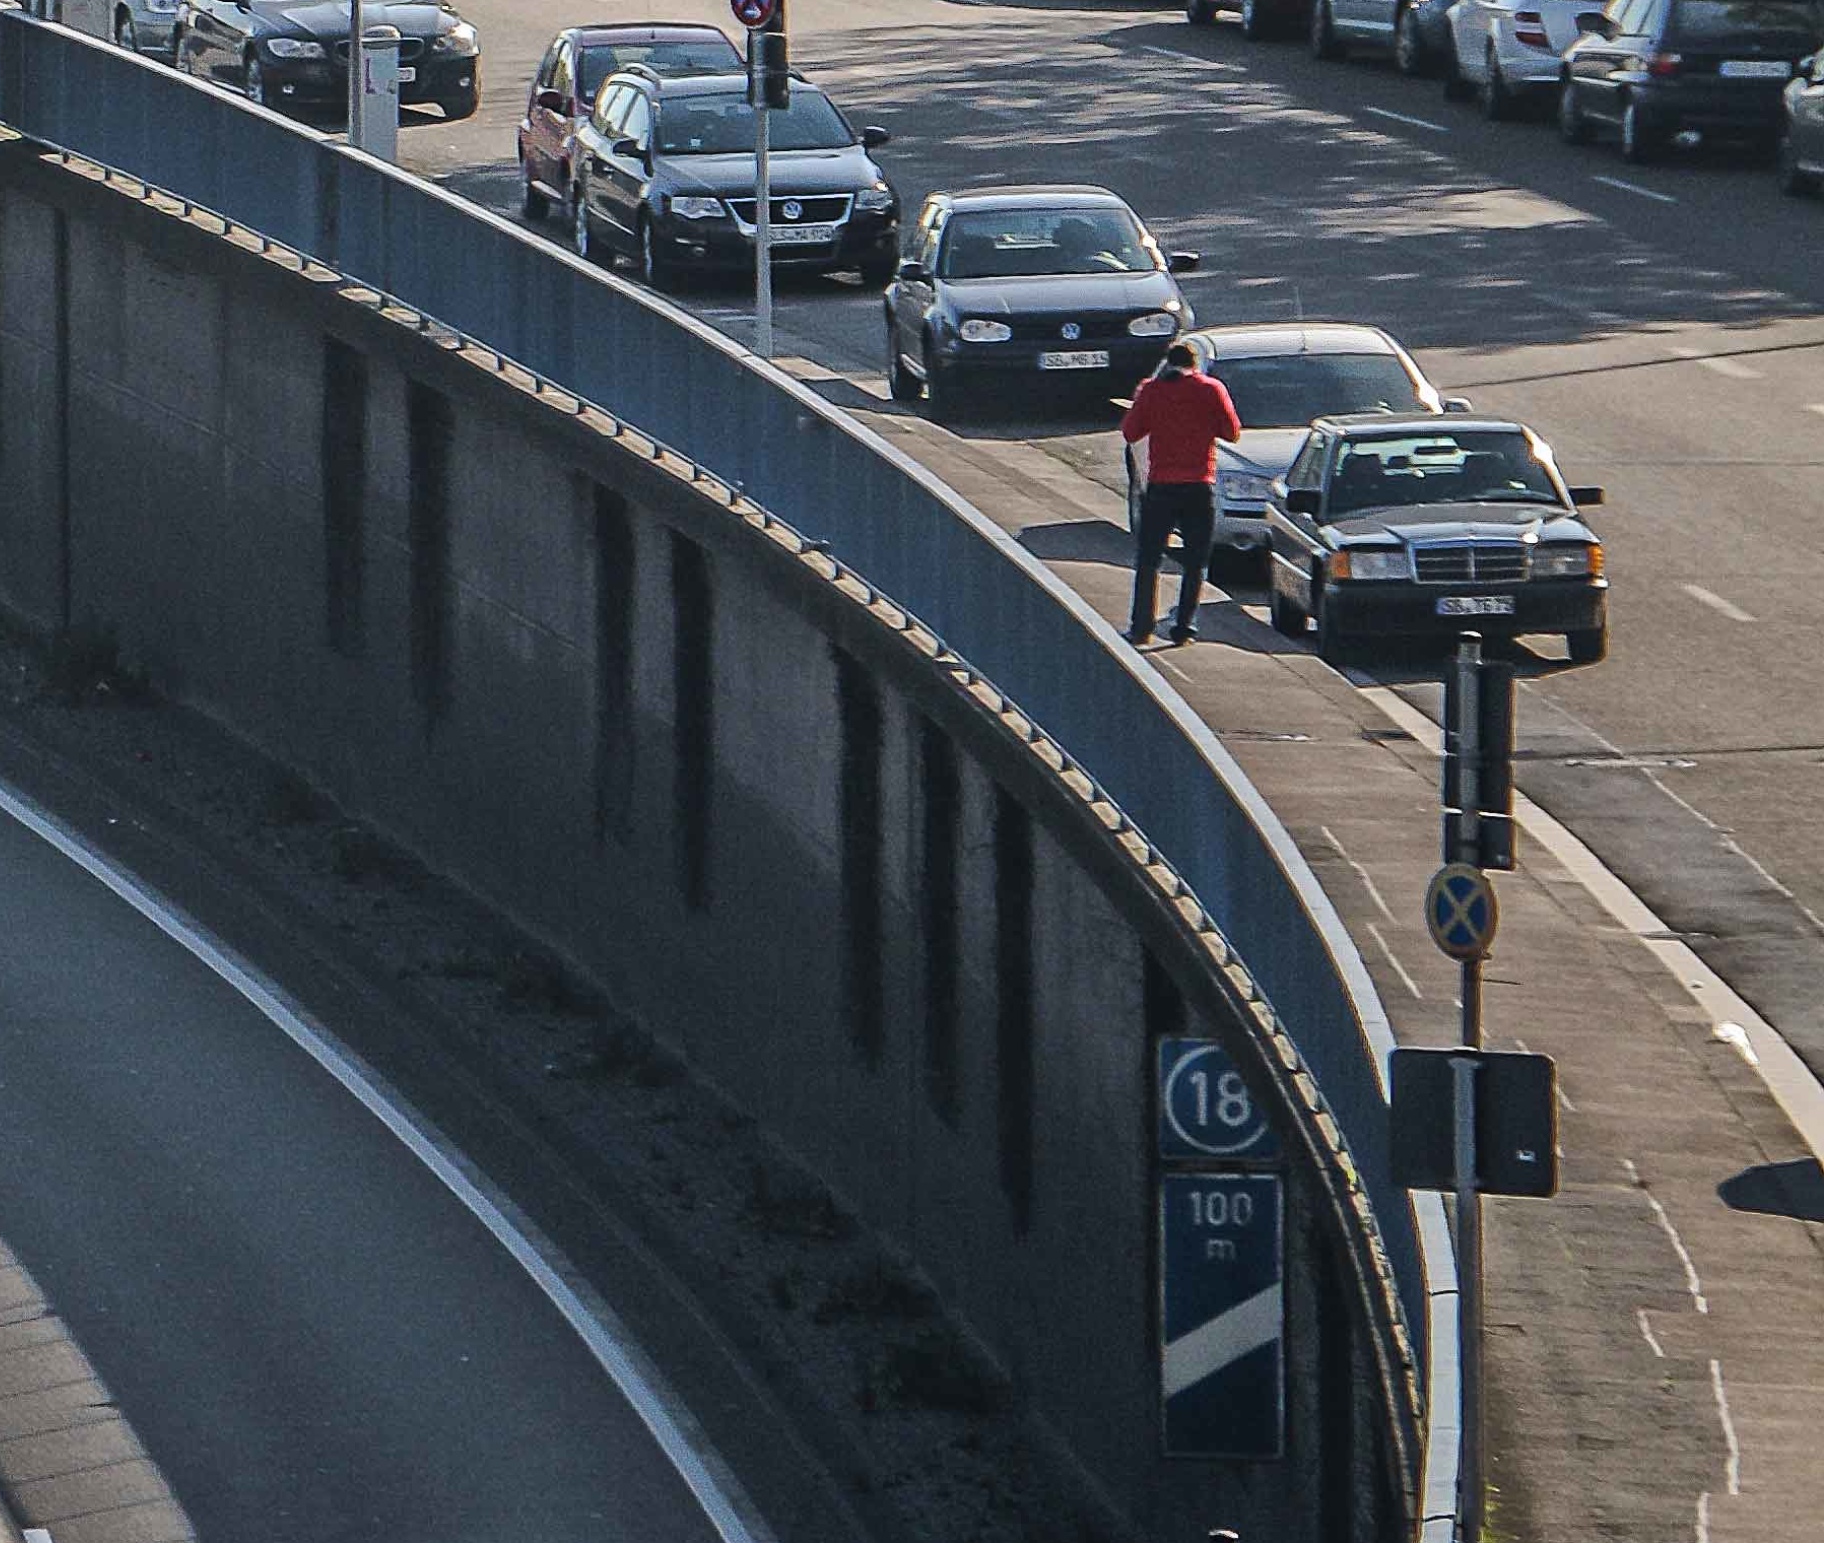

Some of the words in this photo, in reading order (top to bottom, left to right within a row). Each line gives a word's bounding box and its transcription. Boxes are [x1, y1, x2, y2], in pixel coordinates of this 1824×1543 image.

[1189, 1069, 1252, 1127] 18
[1188, 1190, 1254, 1227] 100
[1205, 1238, 1236, 1261] m
